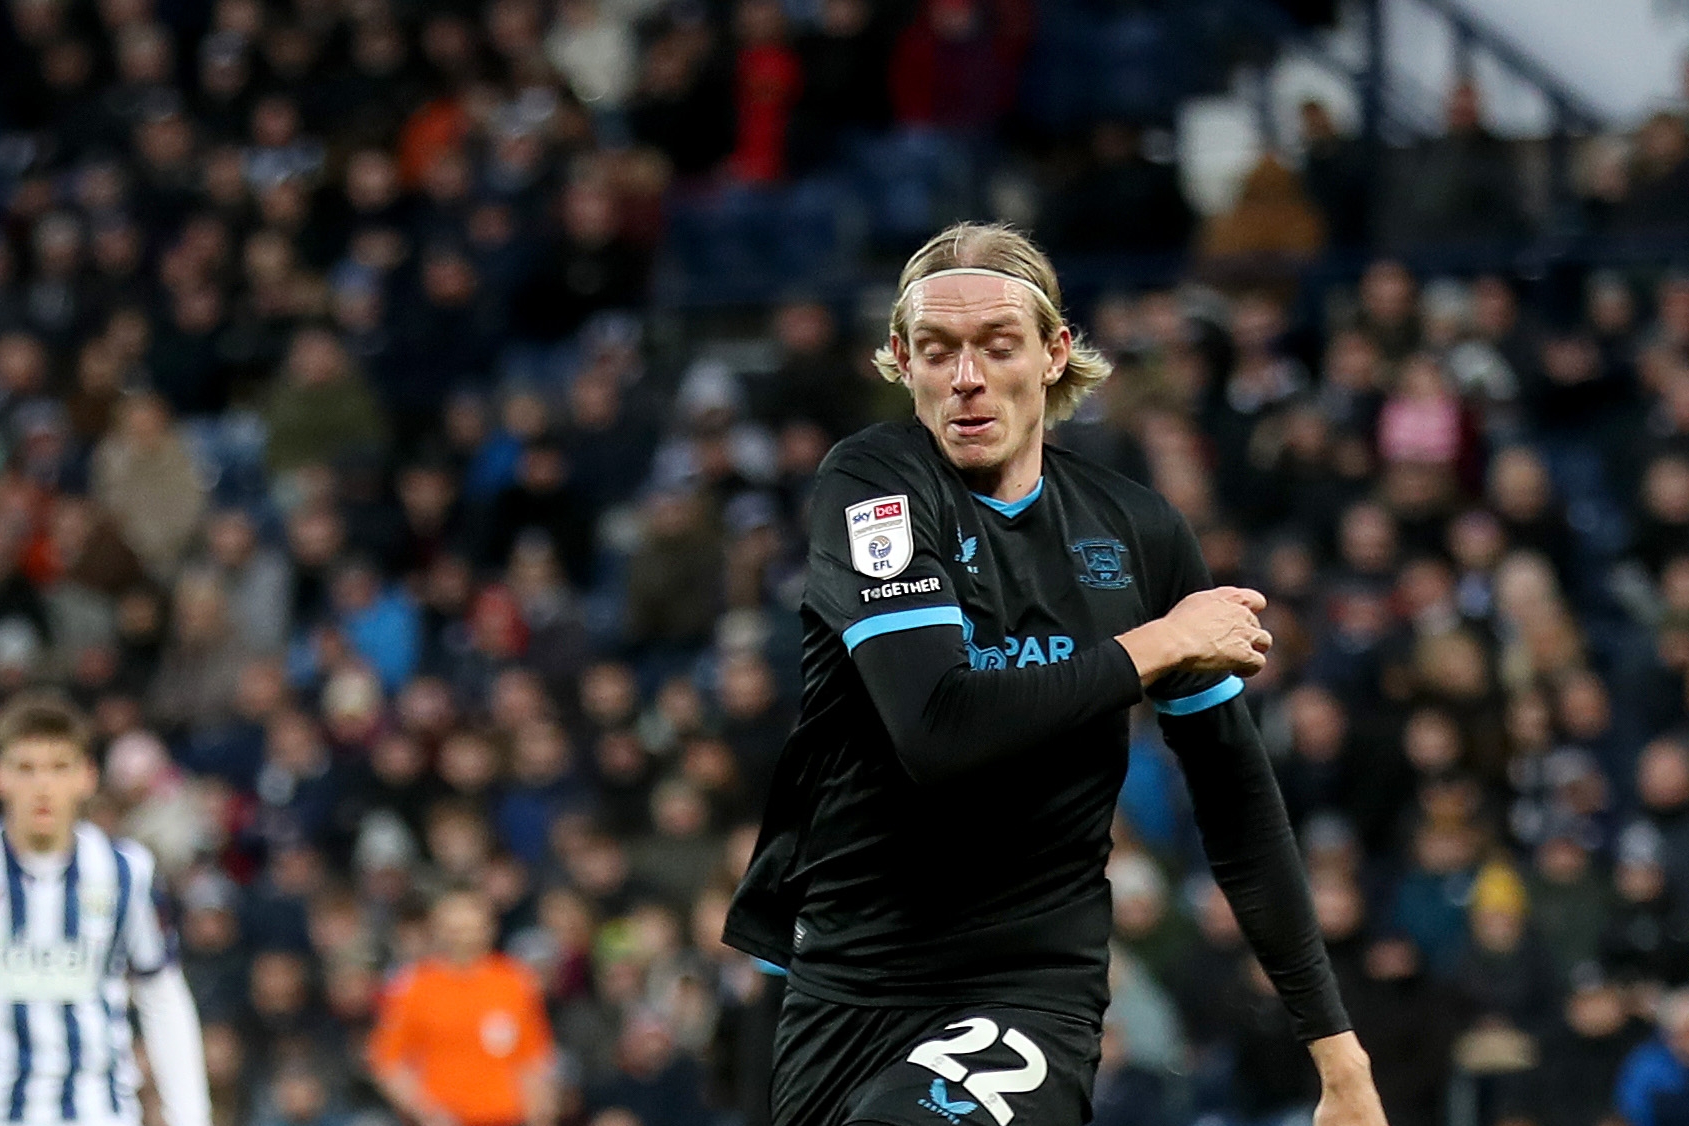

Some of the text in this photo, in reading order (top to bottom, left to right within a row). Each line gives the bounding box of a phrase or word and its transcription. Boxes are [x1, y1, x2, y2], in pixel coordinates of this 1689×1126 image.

[852, 503, 900, 525] sky bet
[872, 559, 893, 572] EFL
[860, 577, 942, 603] TOGETHER
